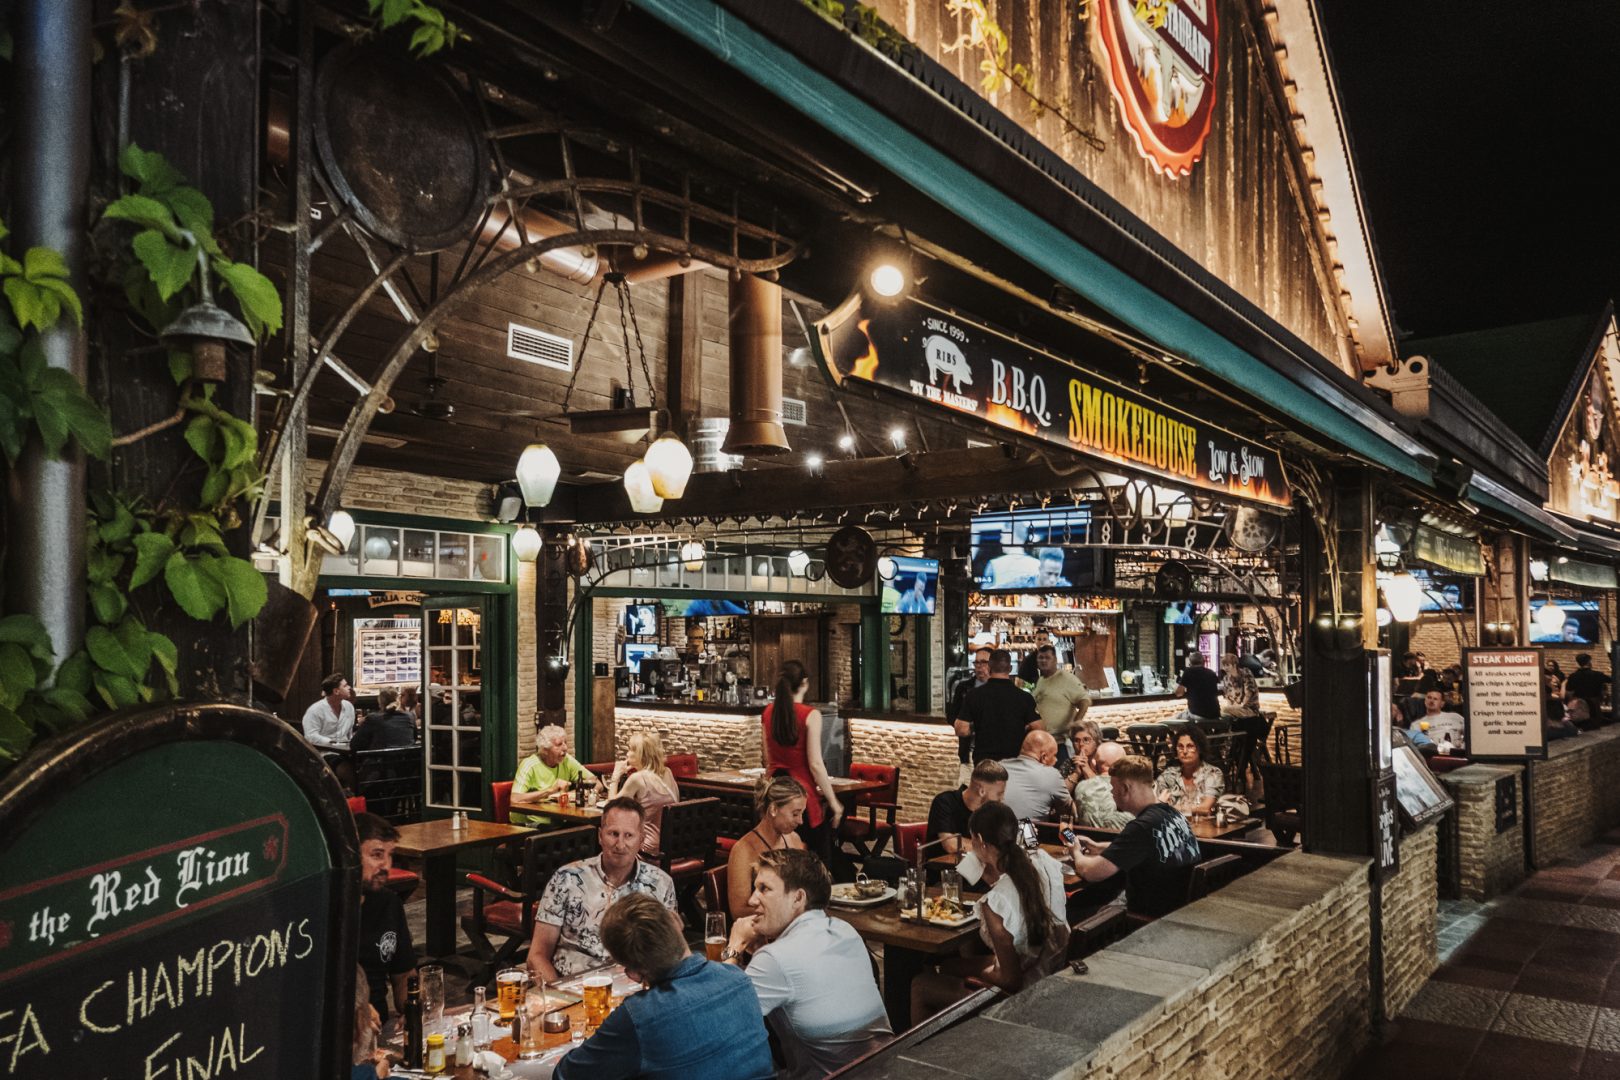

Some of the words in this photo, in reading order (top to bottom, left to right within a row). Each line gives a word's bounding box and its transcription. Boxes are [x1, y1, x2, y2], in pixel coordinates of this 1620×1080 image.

[927, 317, 948, 333] SINCE
[949, 325, 965, 342] 1999
[936, 348, 956, 366] RIBS
[926, 384, 942, 402] THE
[991, 358, 1051, 427] B.B.Q.
[1068, 378, 1197, 479] SMOKEHOUSE
[1230, 451, 1239, 475] &
[1472, 655, 1501, 664] STEAK
[1504, 655, 1535, 664] NIGHT
[28, 906, 70, 946] the
[87, 866, 161, 938] Red
[176, 846, 250, 909] Lion
[79, 918, 313, 1034] CHAMPIONS
[144, 1022, 265, 1080] FINAL
